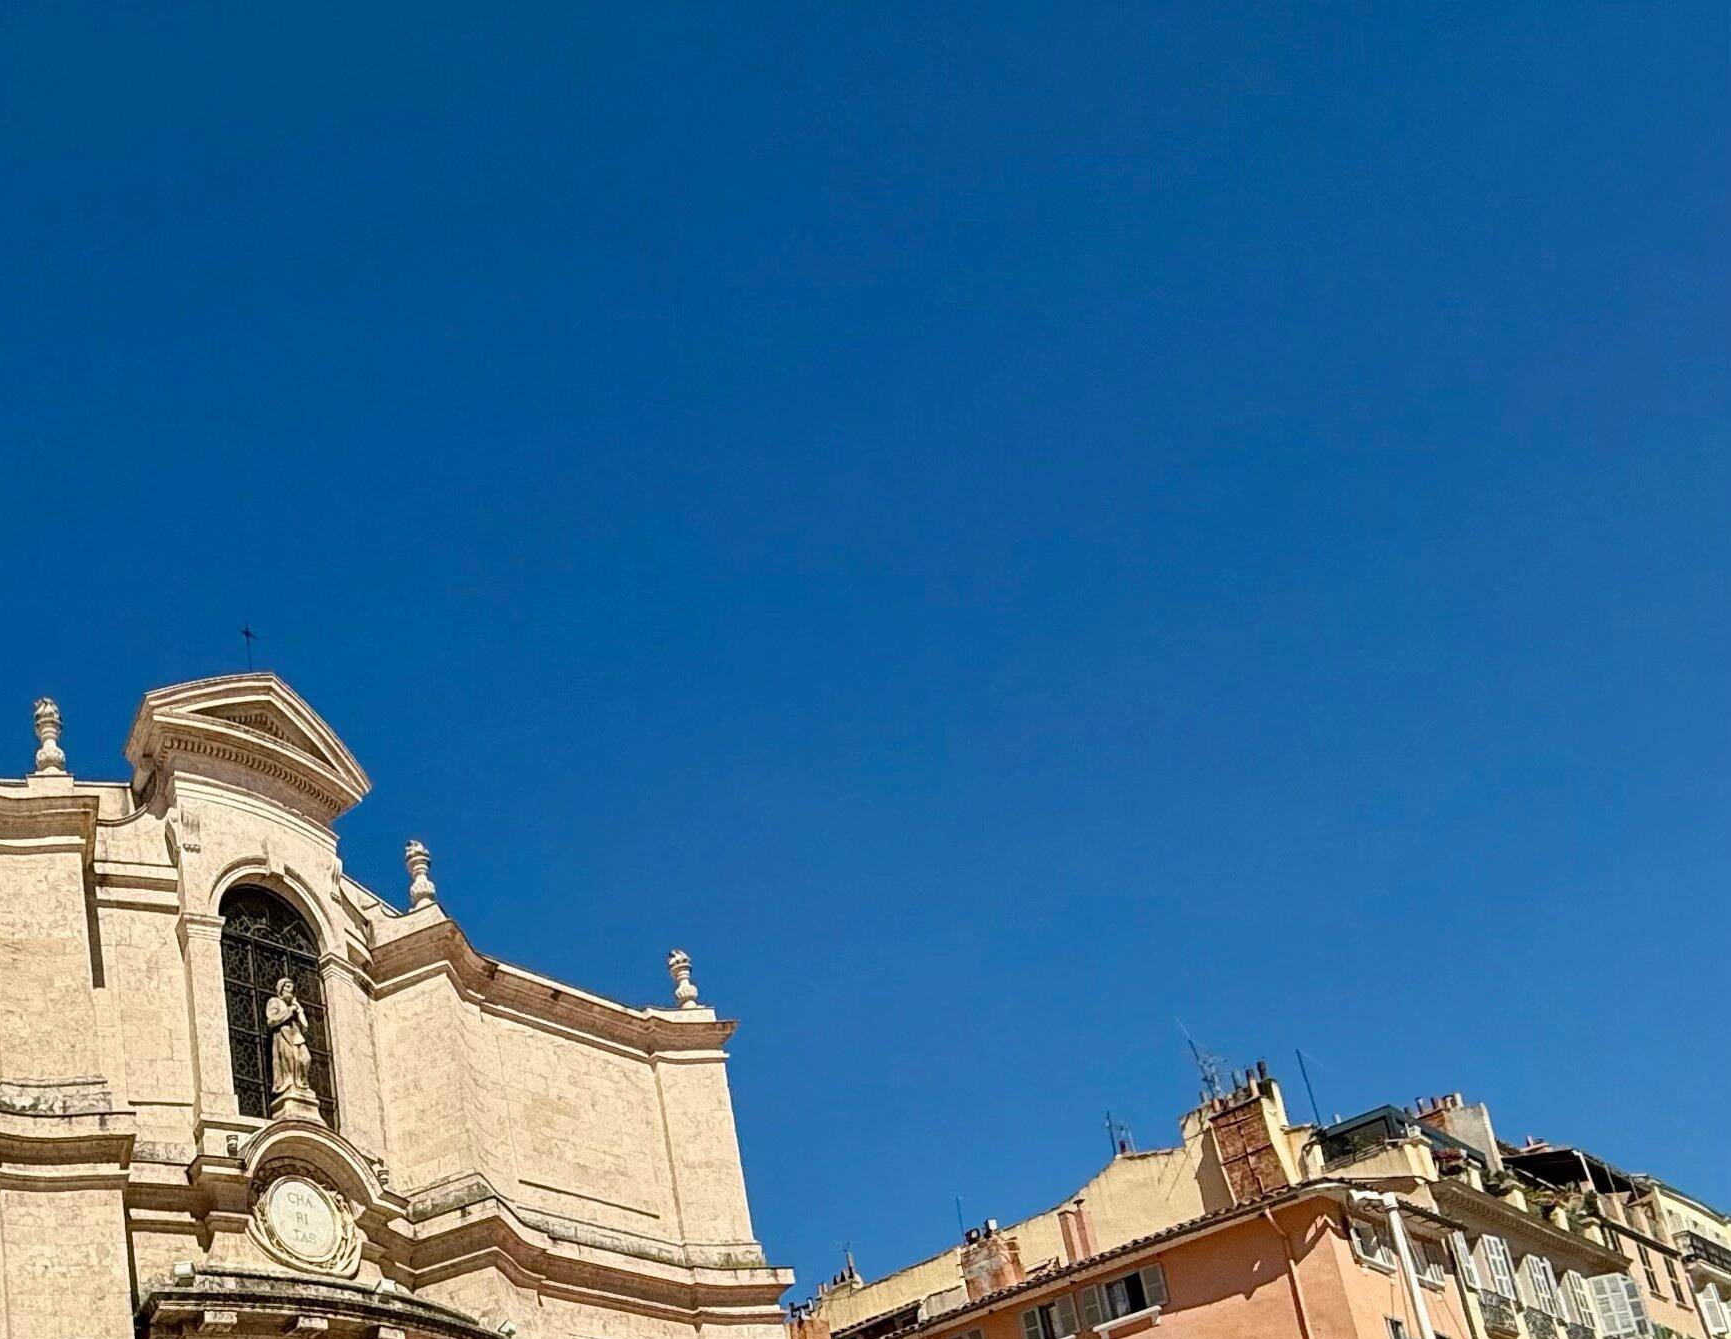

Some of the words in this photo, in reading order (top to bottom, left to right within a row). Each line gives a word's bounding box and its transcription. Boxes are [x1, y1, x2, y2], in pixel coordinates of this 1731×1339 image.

[287, 1191, 314, 1208] CHA
[296, 1211, 309, 1225] RI
[293, 1229, 317, 1245] TAS
